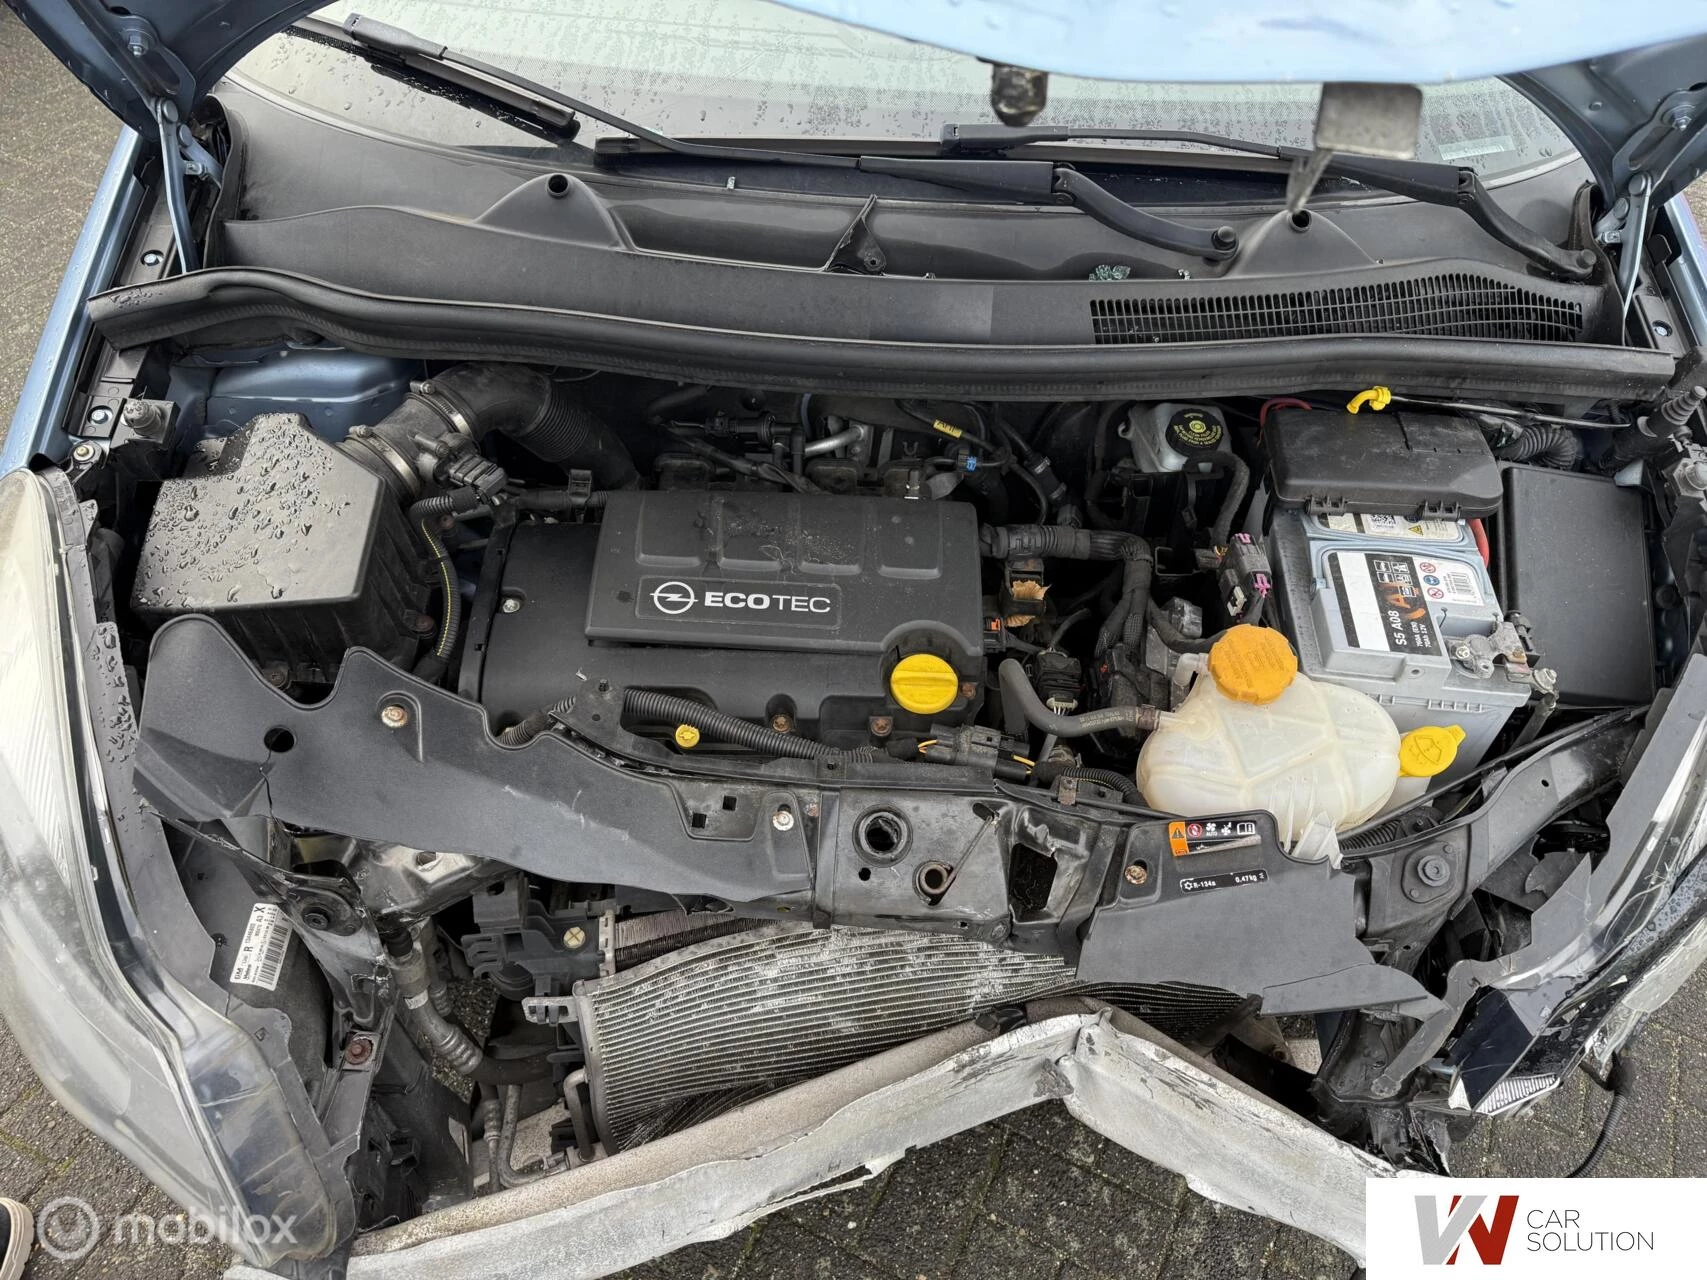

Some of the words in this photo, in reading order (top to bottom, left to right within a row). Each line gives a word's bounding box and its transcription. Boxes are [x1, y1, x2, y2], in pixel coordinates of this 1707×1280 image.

[703, 591, 831, 613] ECOTEC
[1387, 610, 1404, 631] A08
[1393, 632, 1408, 646] S5
